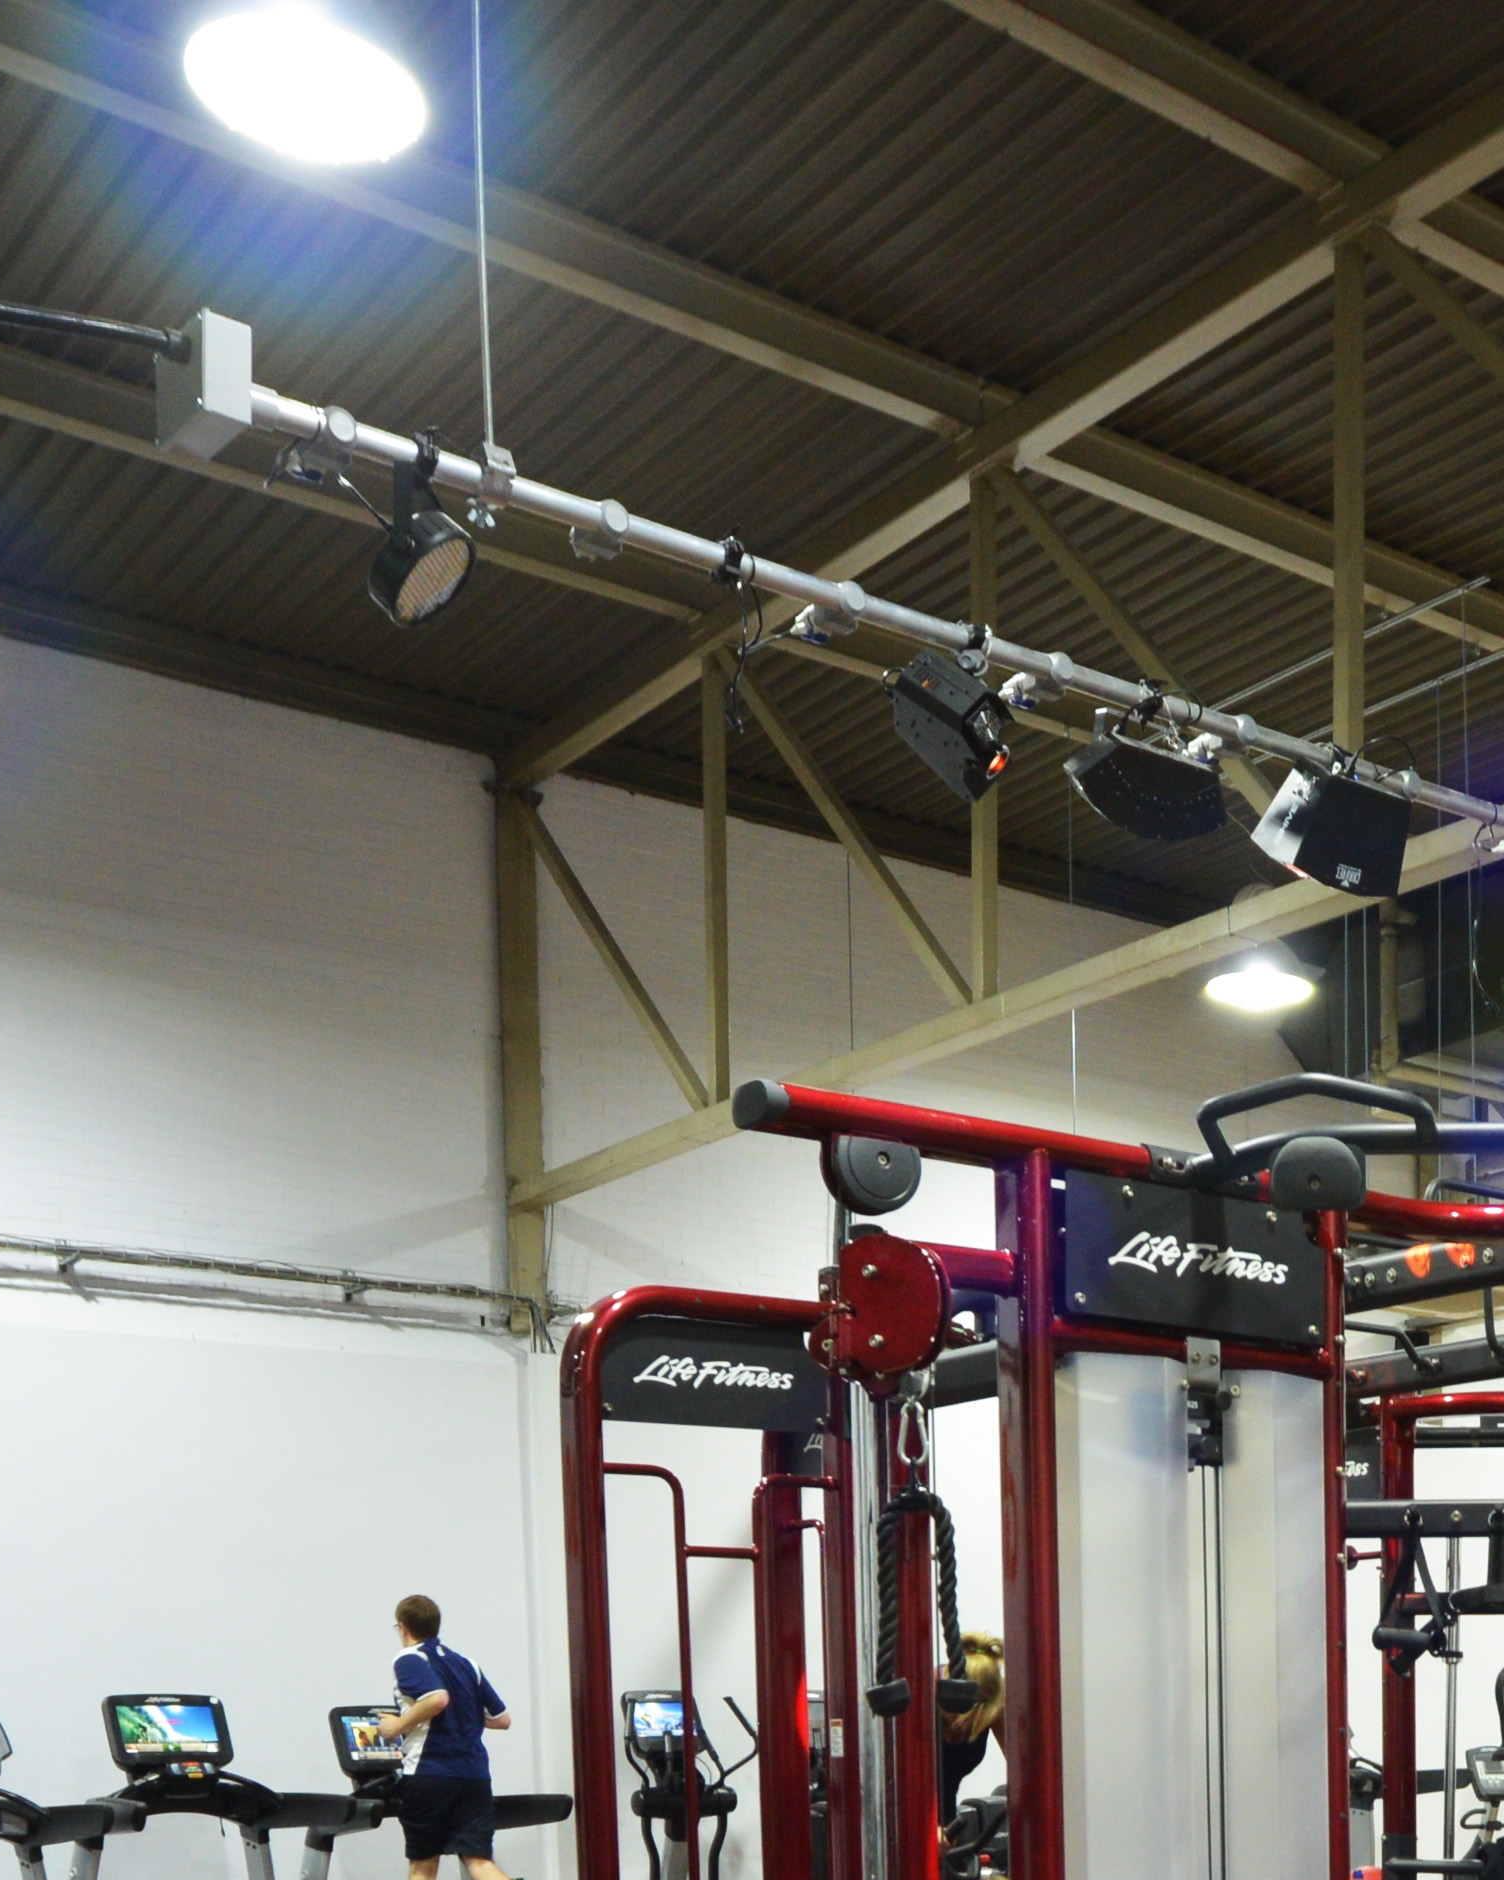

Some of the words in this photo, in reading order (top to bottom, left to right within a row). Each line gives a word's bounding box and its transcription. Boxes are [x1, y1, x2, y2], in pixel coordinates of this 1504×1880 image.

[1108, 1231, 1181, 1274] Life
[1176, 1243, 1289, 1285] Fitness
[633, 1355, 697, 1386] Life
[693, 1361, 794, 1391] Fitness
